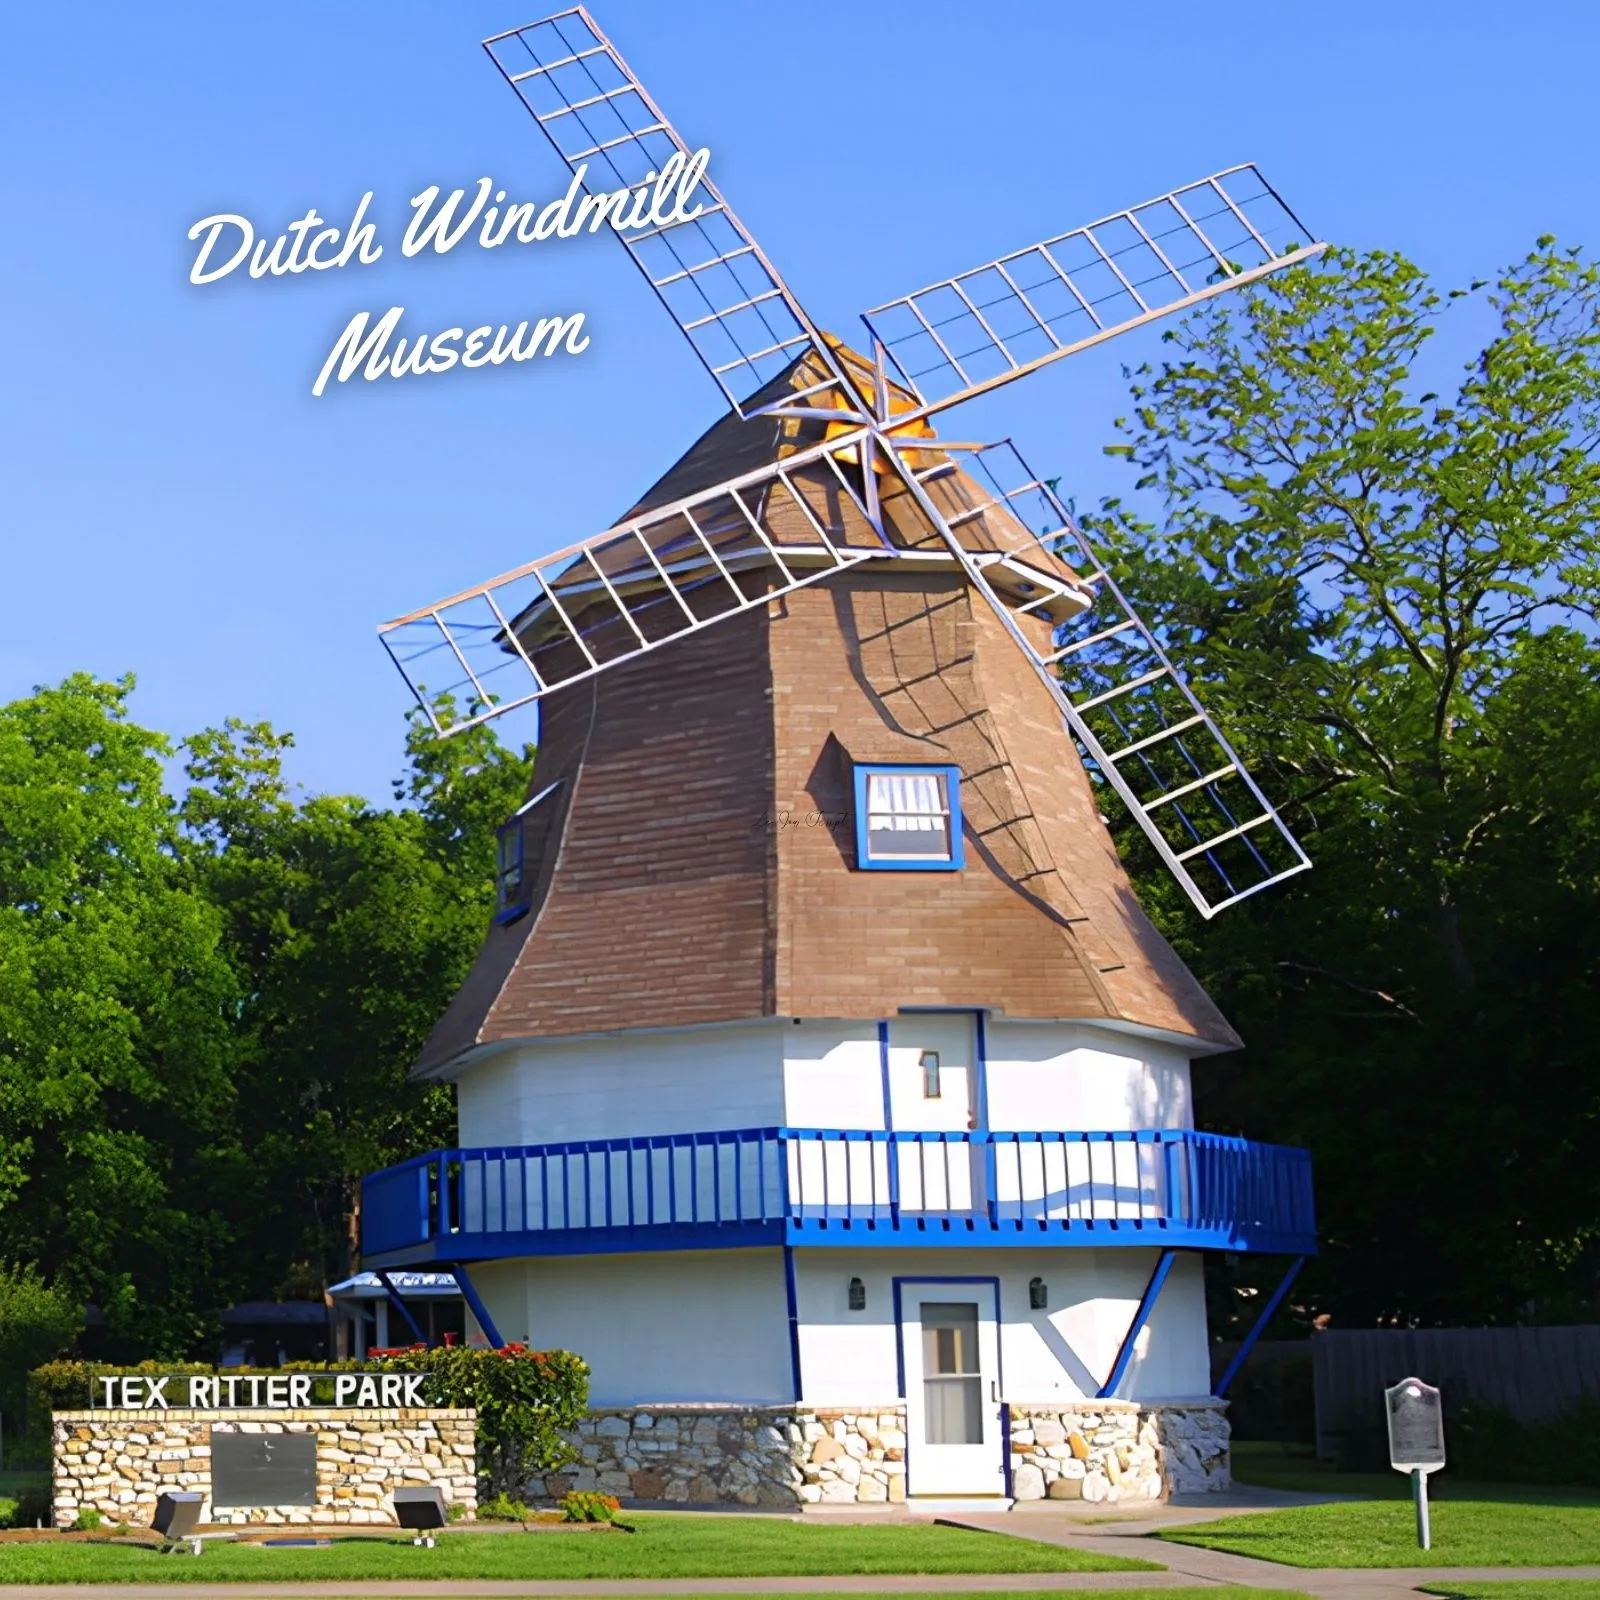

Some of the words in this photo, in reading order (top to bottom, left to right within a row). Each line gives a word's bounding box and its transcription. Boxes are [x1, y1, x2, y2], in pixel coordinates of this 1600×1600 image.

[99, 1375, 170, 1410] TEX
[189, 1375, 311, 1409] RITTER
[335, 1374, 427, 1408] PARK
